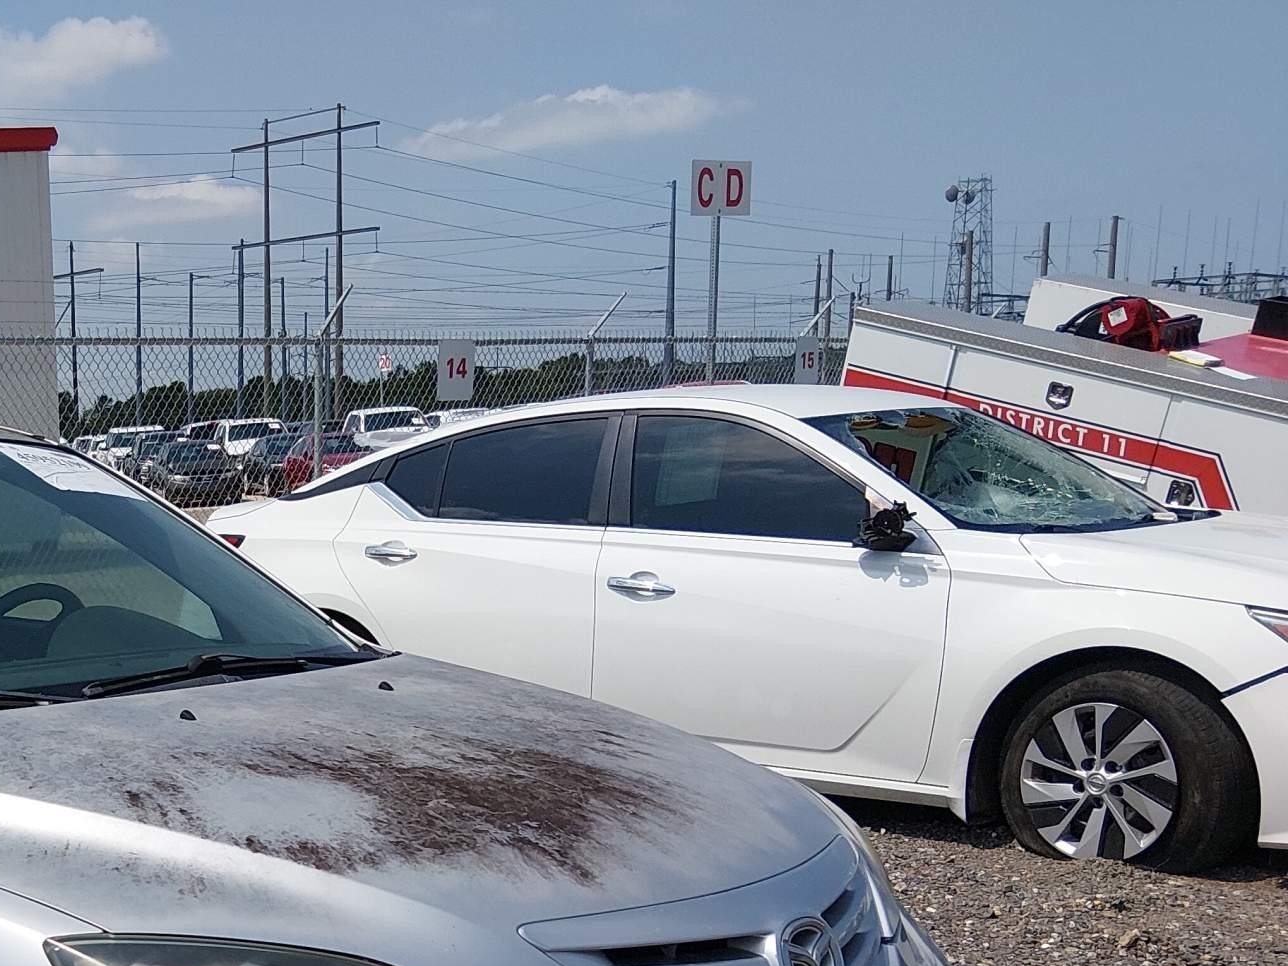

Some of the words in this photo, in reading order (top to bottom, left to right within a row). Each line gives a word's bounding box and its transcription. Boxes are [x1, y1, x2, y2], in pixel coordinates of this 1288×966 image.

[697, 167, 714, 208] C
[726, 168, 743, 207] D
[446, 357, 467, 379] 14
[800, 351, 814, 369] 15
[978, 403, 1088, 447] DISTRICT
[1102, 433, 1128, 457] 11
